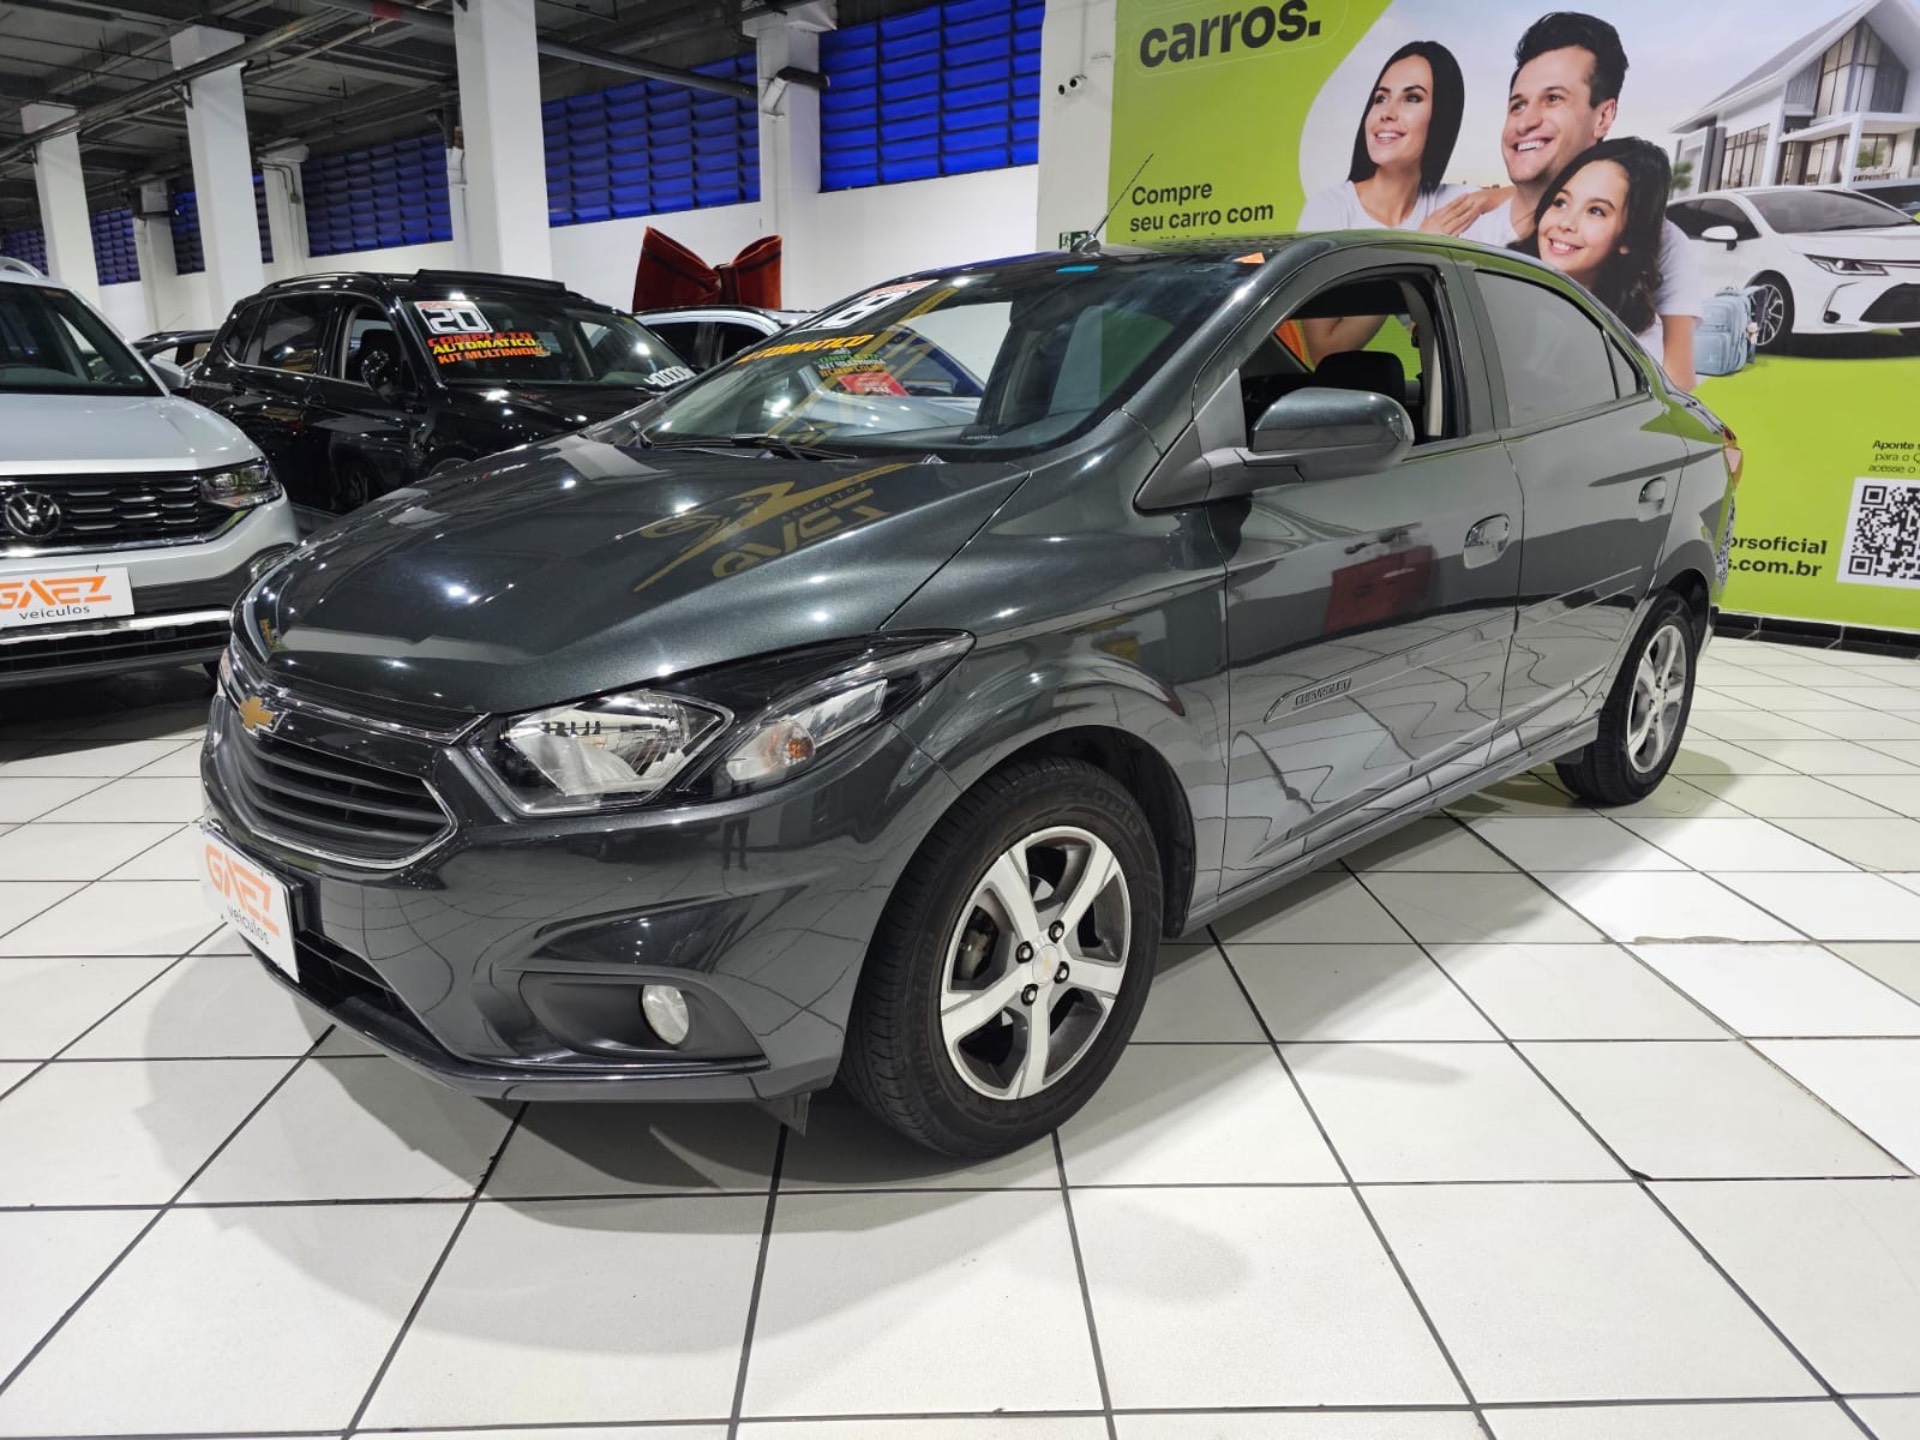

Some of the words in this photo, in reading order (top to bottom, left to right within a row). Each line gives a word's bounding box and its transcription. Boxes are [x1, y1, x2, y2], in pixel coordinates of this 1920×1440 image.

[1140, 0, 1321, 68] carros.
[1132, 183, 1213, 206] Compre
[1130, 215, 1164, 232] seu
[1168, 209, 1222, 229] carro
[1226, 204, 1274, 223] com
[427, 308, 488, 332] 20
[426, 331, 533, 347] COMPLETO
[433, 338, 537, 354] AUTOMATICO
[437, 353, 463, 364] KIT
[1872, 440, 1915, 450] Aponte
[1875, 454, 1900, 463] para
[1902, 454, 1910, 462] o
[1908, 466, 1916, 474] o
